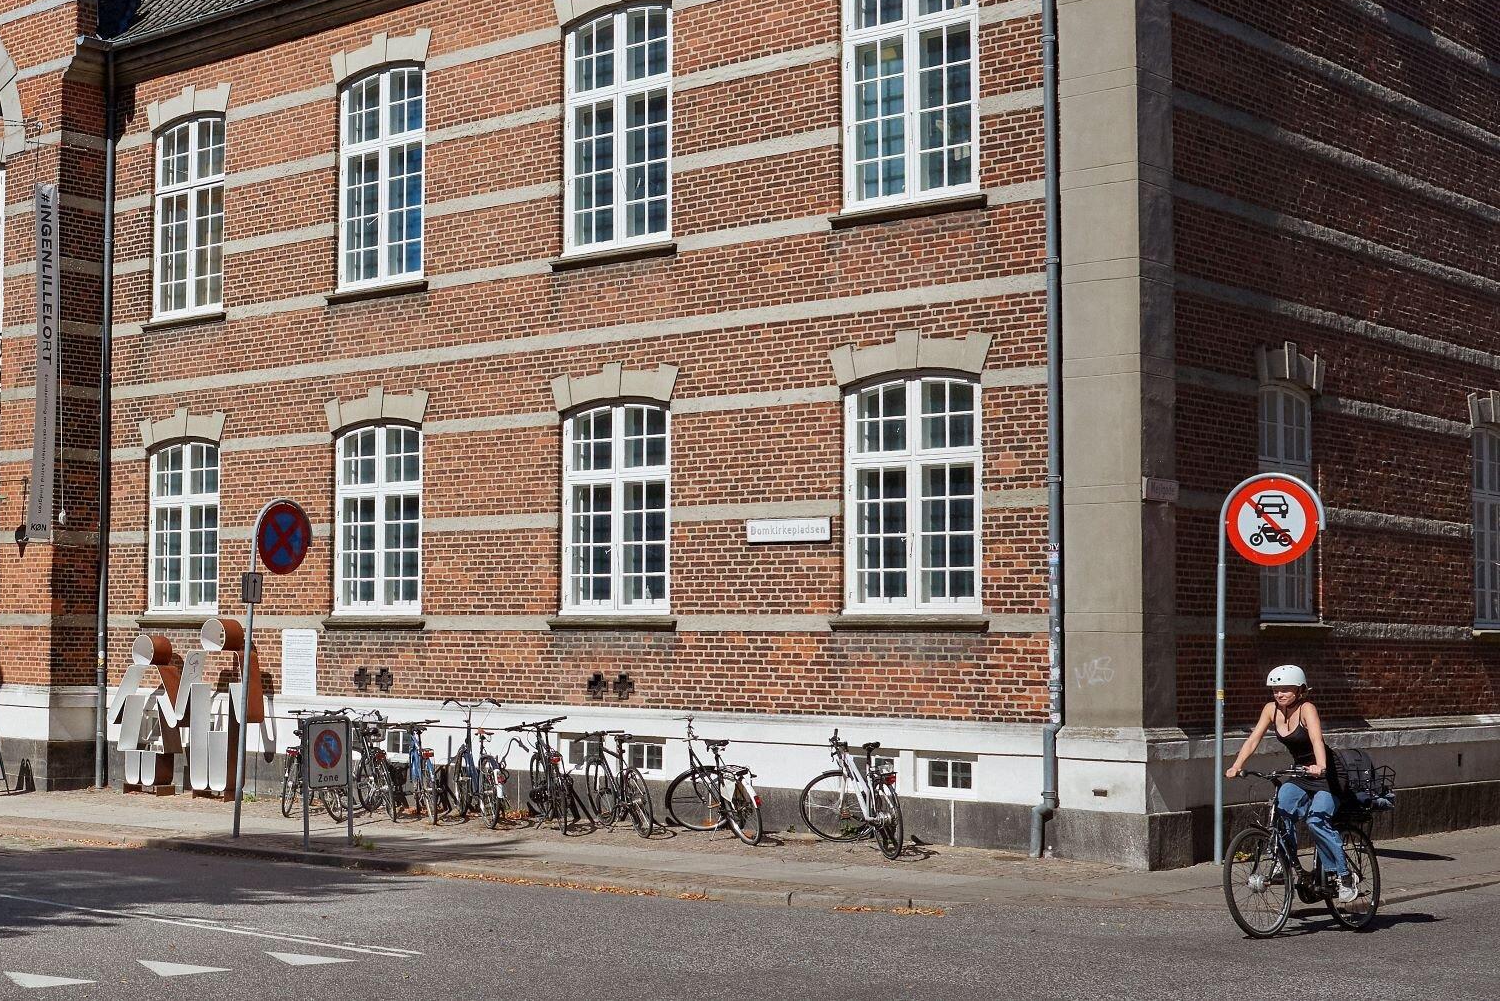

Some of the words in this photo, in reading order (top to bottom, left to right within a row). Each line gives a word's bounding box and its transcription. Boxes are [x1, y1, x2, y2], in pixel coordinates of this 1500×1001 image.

[40, 193, 53, 365] #INGENLILLELORT
[30, 523, 47, 532] KØN
[750, 524, 826, 536] Domkirkepladsen
[318, 773, 339, 783] Zone
